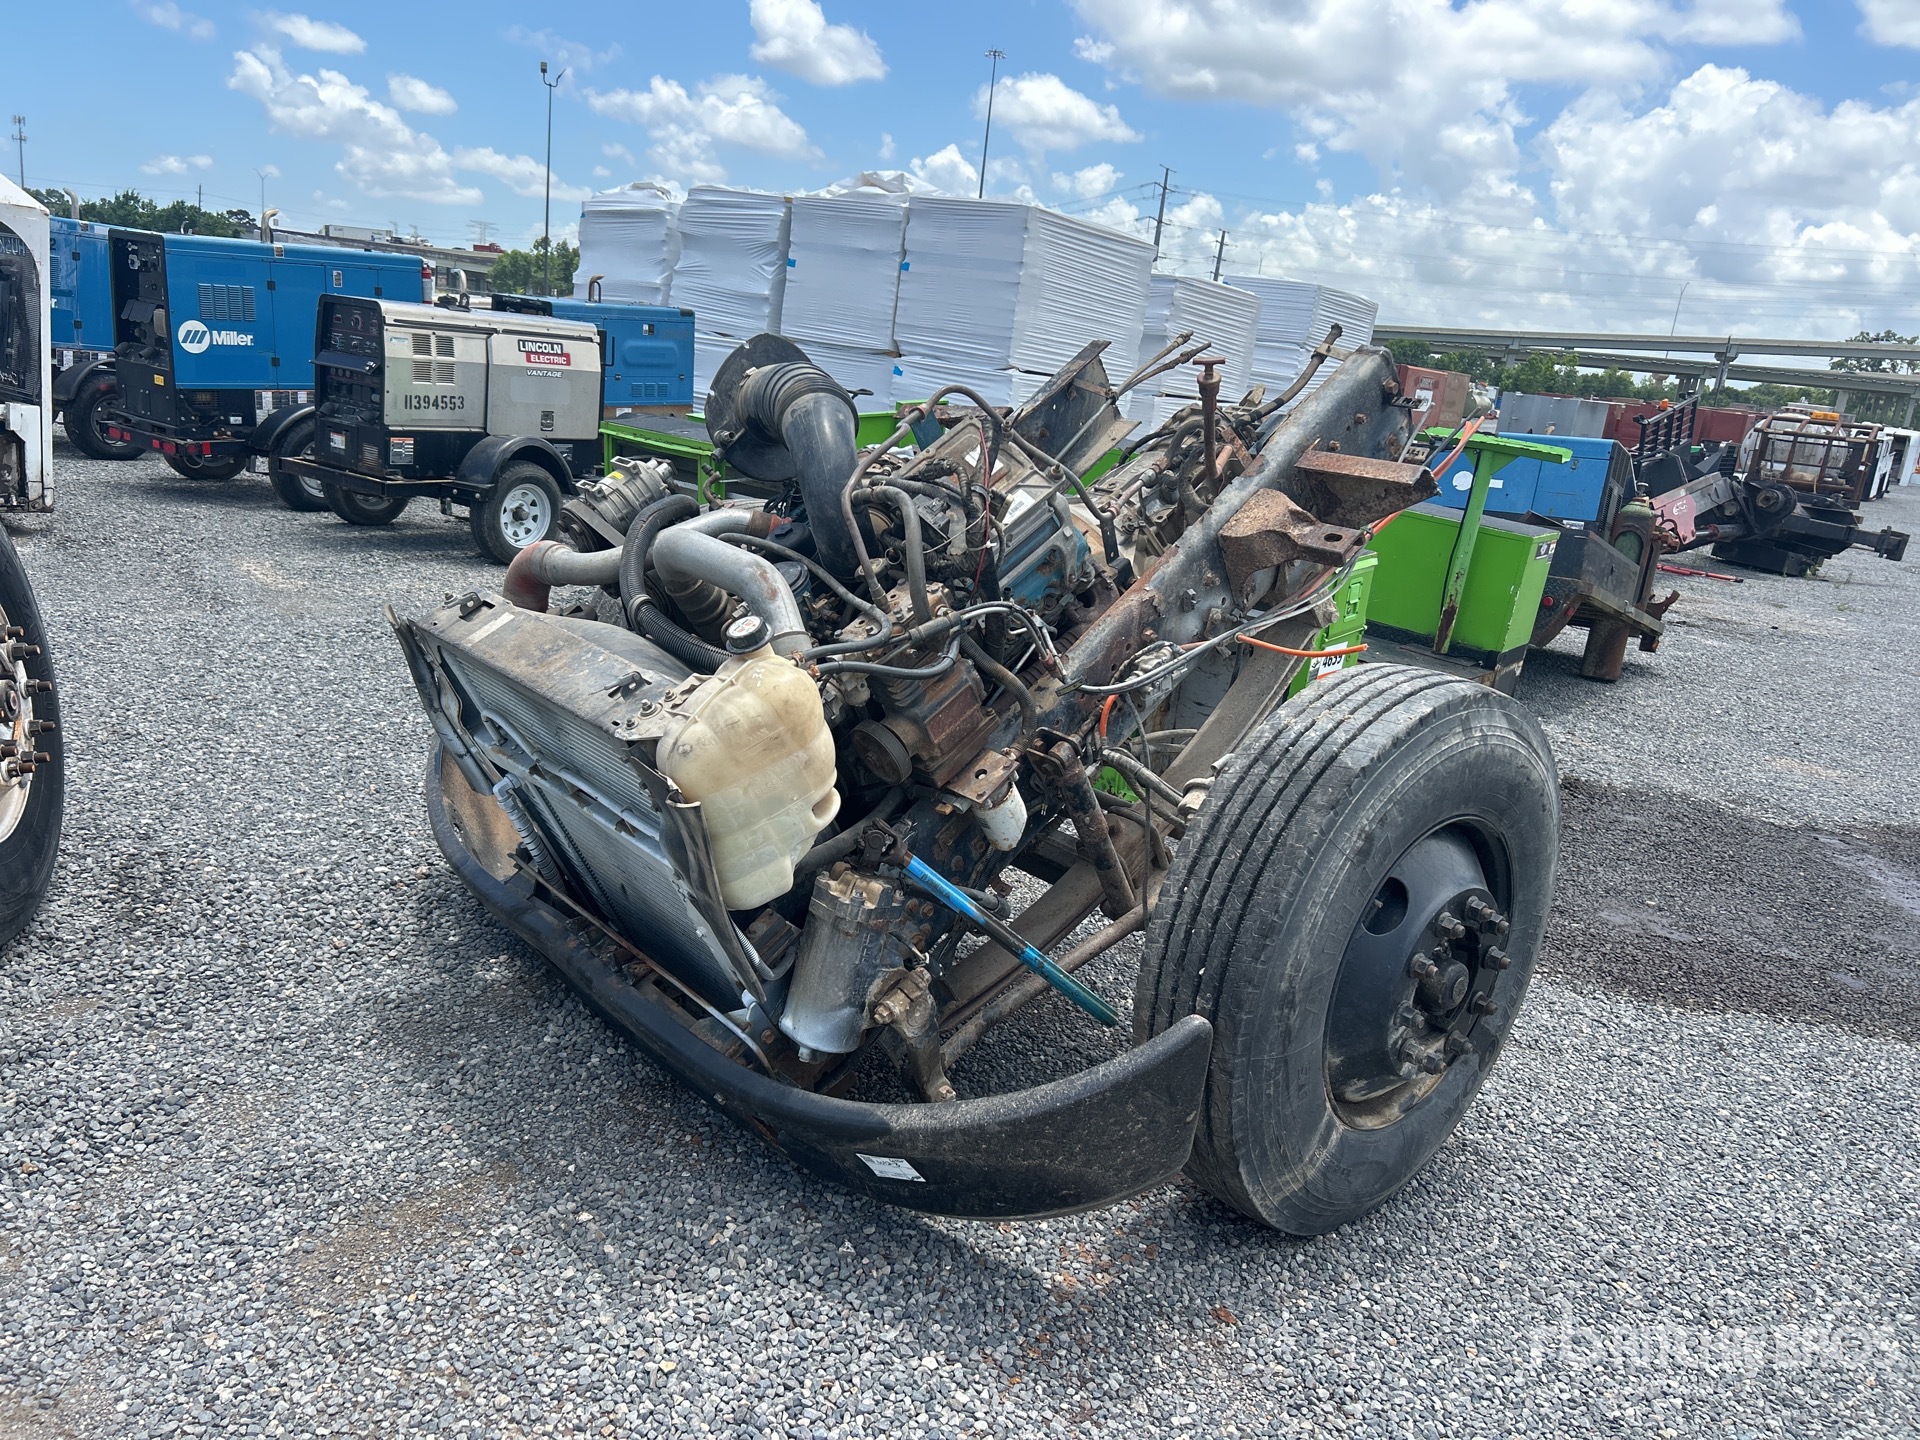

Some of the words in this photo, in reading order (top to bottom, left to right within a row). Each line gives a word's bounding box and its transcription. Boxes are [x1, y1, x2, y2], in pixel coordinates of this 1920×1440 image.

[520, 341, 562, 354] LINCOLN
[530, 354, 567, 365] ELECTRIC
[526, 369, 563, 378] VANTAGE
[404, 394, 465, 411] 11394553
